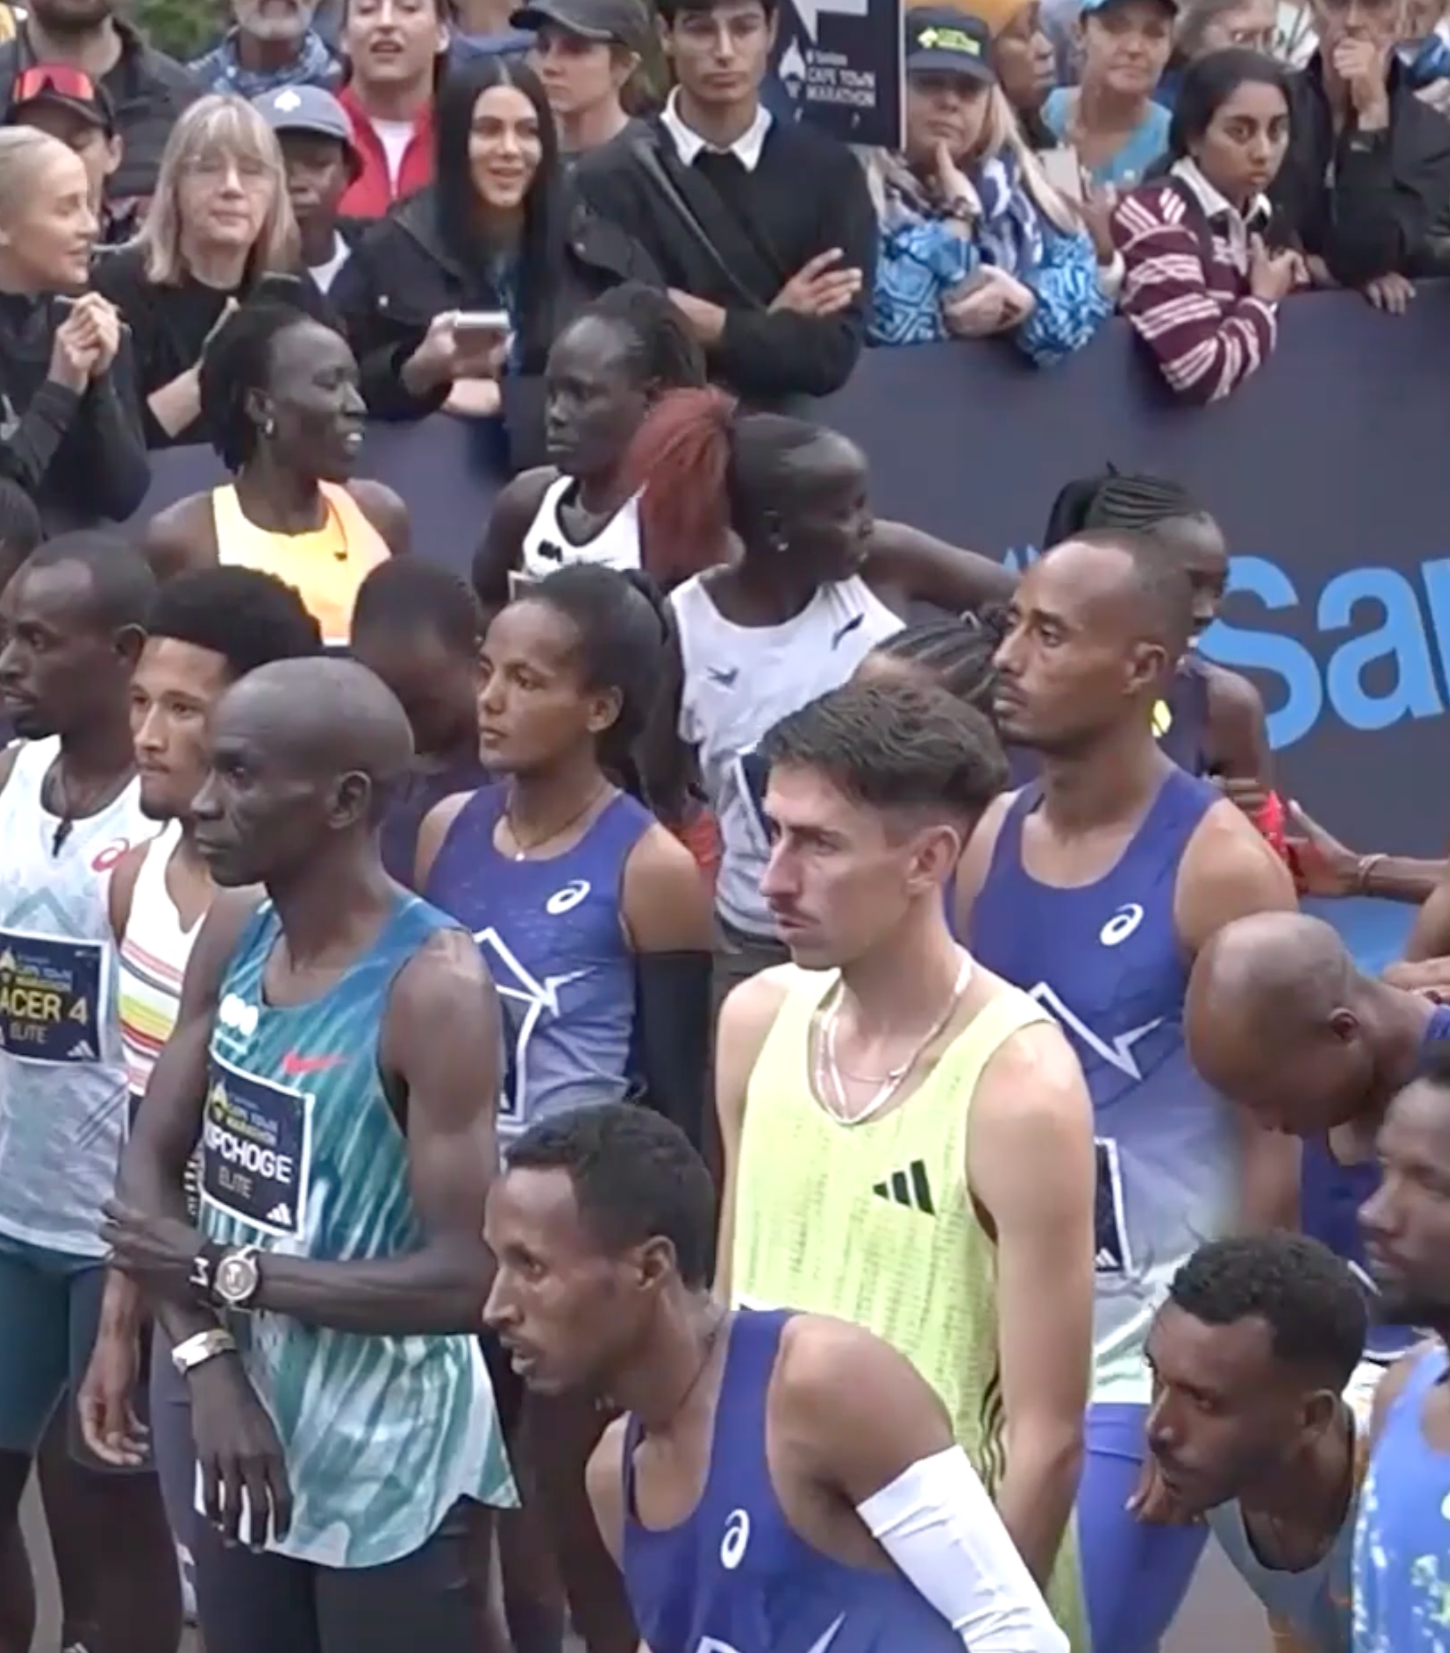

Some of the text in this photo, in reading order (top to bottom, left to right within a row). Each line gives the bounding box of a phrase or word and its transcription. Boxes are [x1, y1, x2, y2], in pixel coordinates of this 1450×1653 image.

[70, 996, 88, 1026] 4
[9, 1020, 48, 1044] ELITE
[218, 1164, 253, 1199] ELITE
